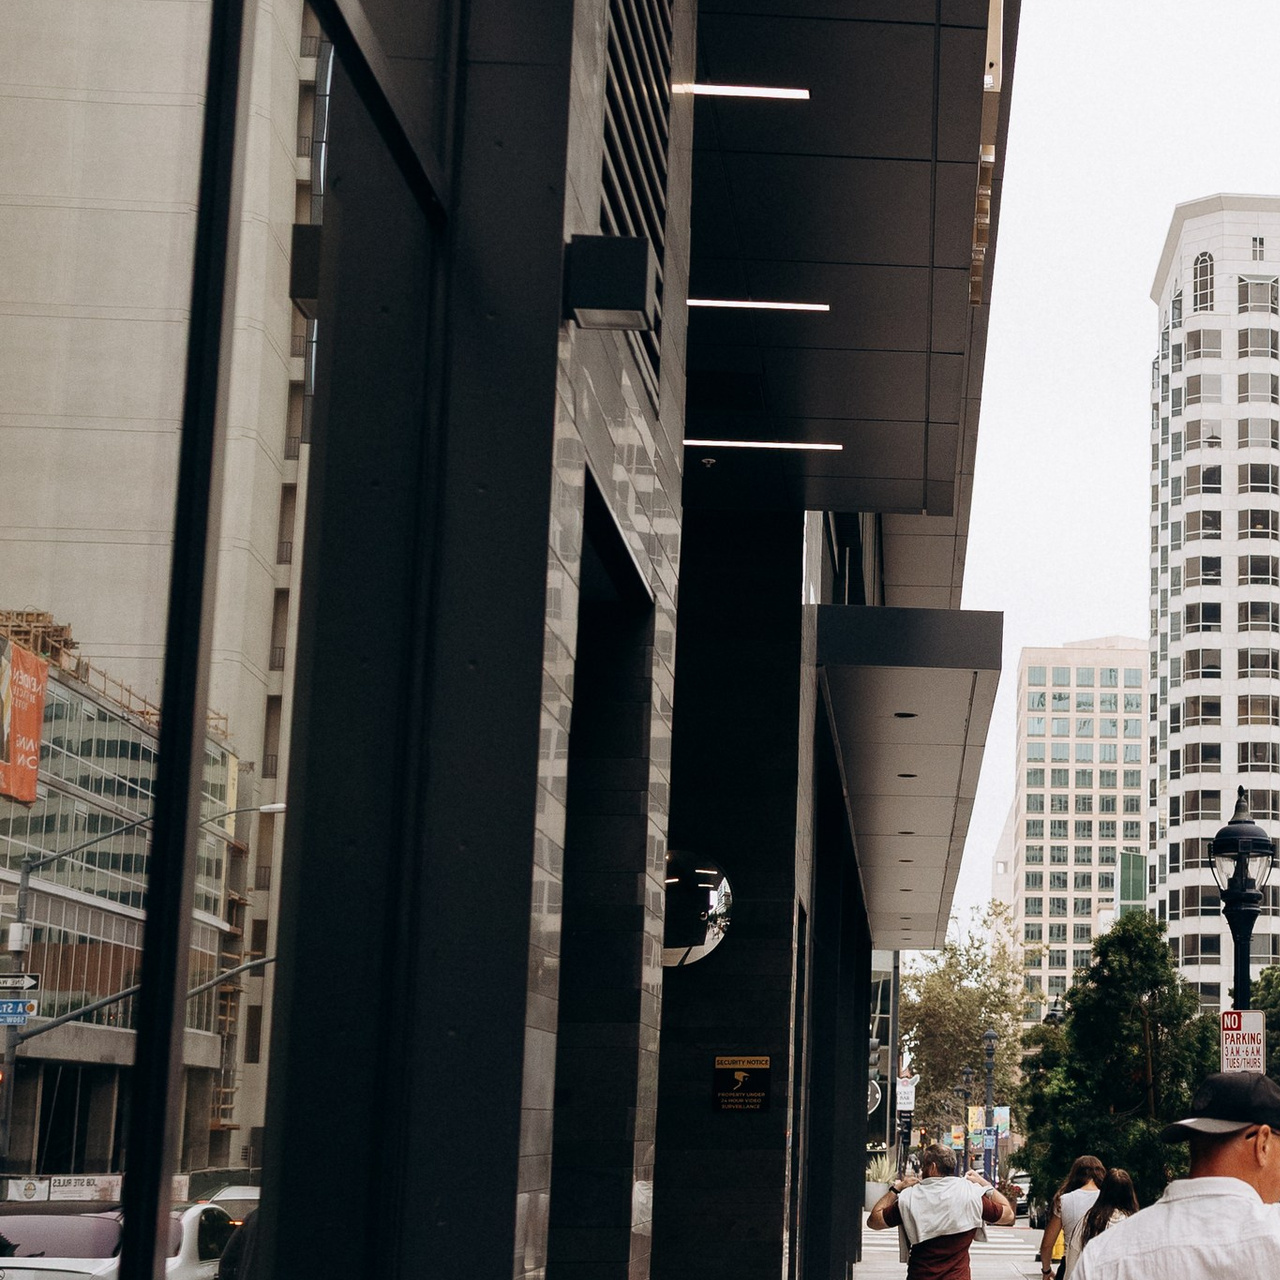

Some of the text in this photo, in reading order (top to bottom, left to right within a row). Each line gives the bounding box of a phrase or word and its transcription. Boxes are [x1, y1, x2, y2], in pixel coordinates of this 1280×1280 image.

[1224, 1013, 1239, 1029] NO
[1225, 1032, 1261, 1045] PARKING
[1225, 1046, 1229, 1057] 3
[1226, 1057, 1261, 1069] TUES/THURS
